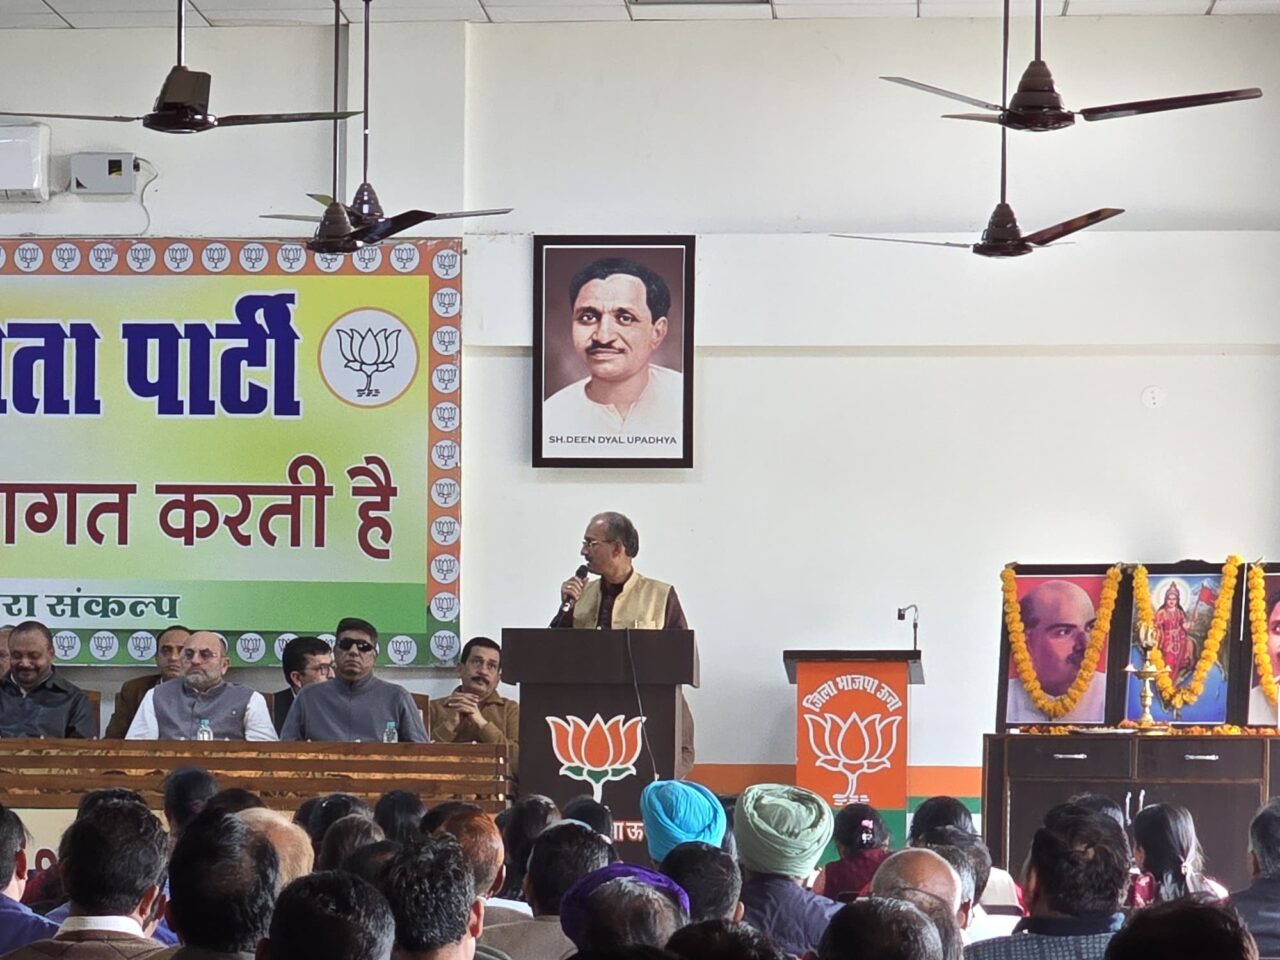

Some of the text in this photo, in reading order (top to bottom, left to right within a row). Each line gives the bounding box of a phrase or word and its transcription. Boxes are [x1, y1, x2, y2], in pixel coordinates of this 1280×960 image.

[121, 293, 301, 416] पार्टी
[598, 435, 625, 444] DYAL
[627, 436, 677, 445] UPADHYA
[155, 455, 334, 547] करती
[346, 455, 398, 560] है
[44, 587, 181, 619] संकल्प
[802, 681, 838, 712] जिला
[836, 674, 879, 694] भाजपा
